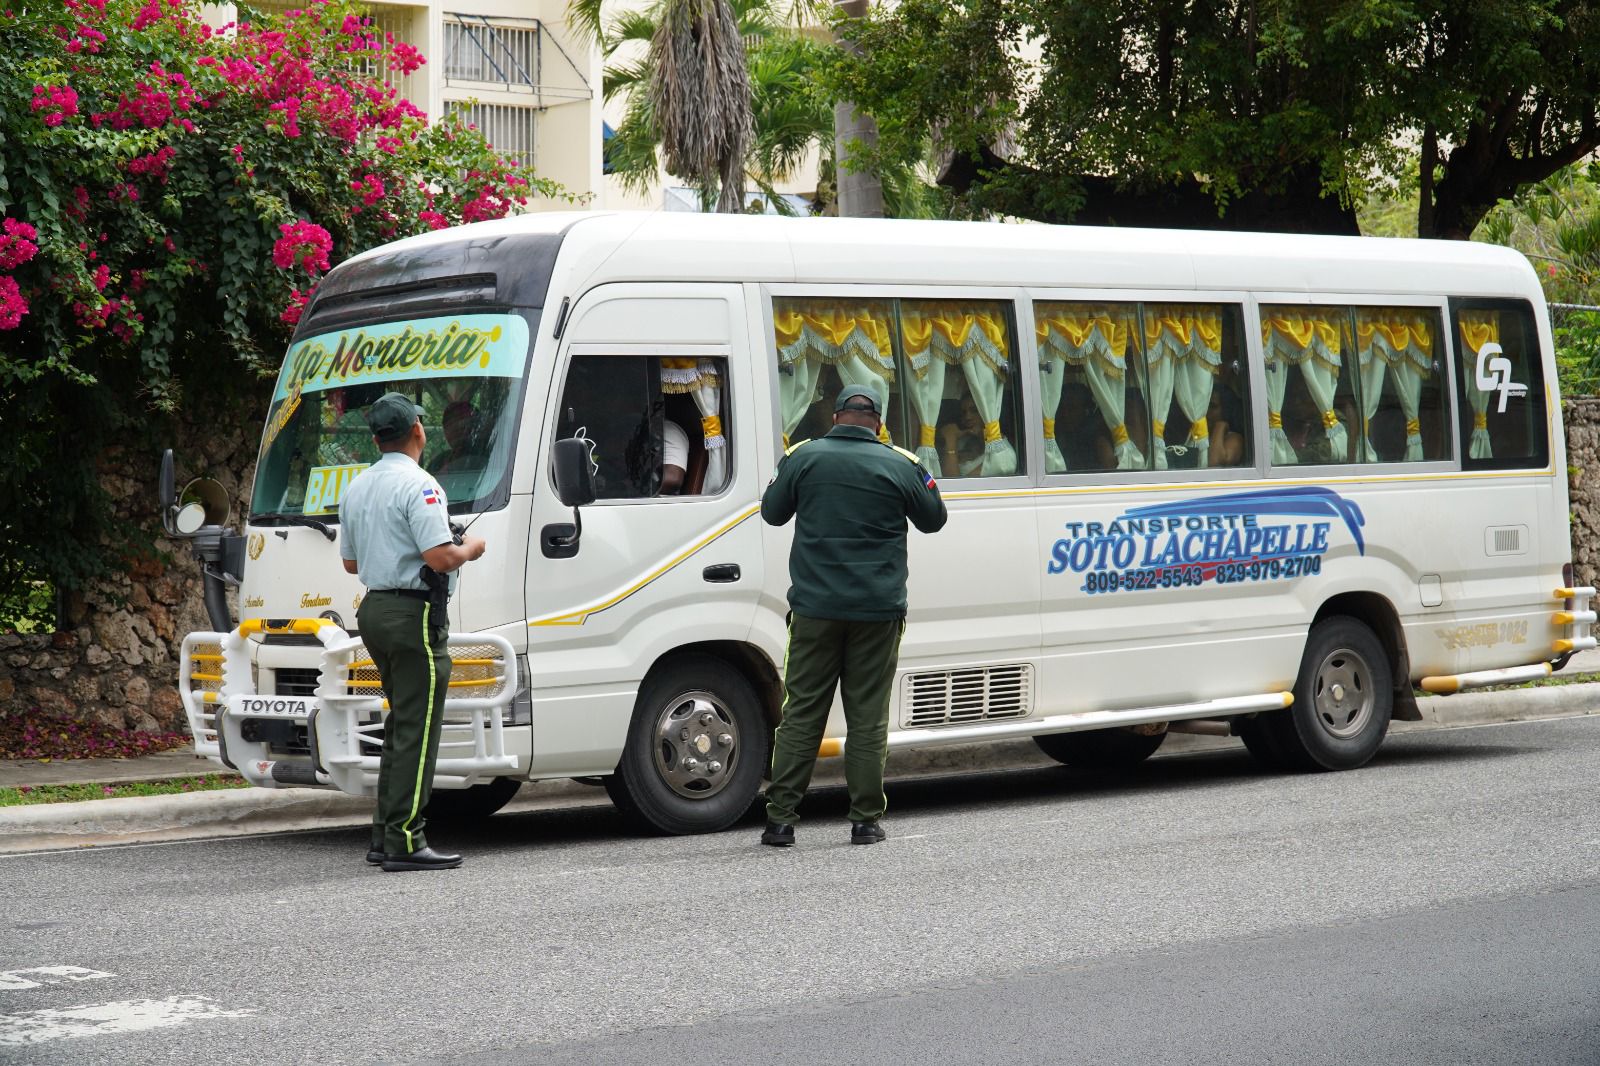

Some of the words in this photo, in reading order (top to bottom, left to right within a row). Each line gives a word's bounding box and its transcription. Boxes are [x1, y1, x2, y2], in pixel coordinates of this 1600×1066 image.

[1066, 514, 1257, 539] TRANSPORTE
[1048, 533, 1137, 575] SOTO
[1140, 522, 1331, 567] LACHAPELLE
[1085, 567, 1203, 593] 809-522-5543
[1215, 555, 1321, 584] 829-979-2700
[241, 699, 307, 714] TOYOTA
